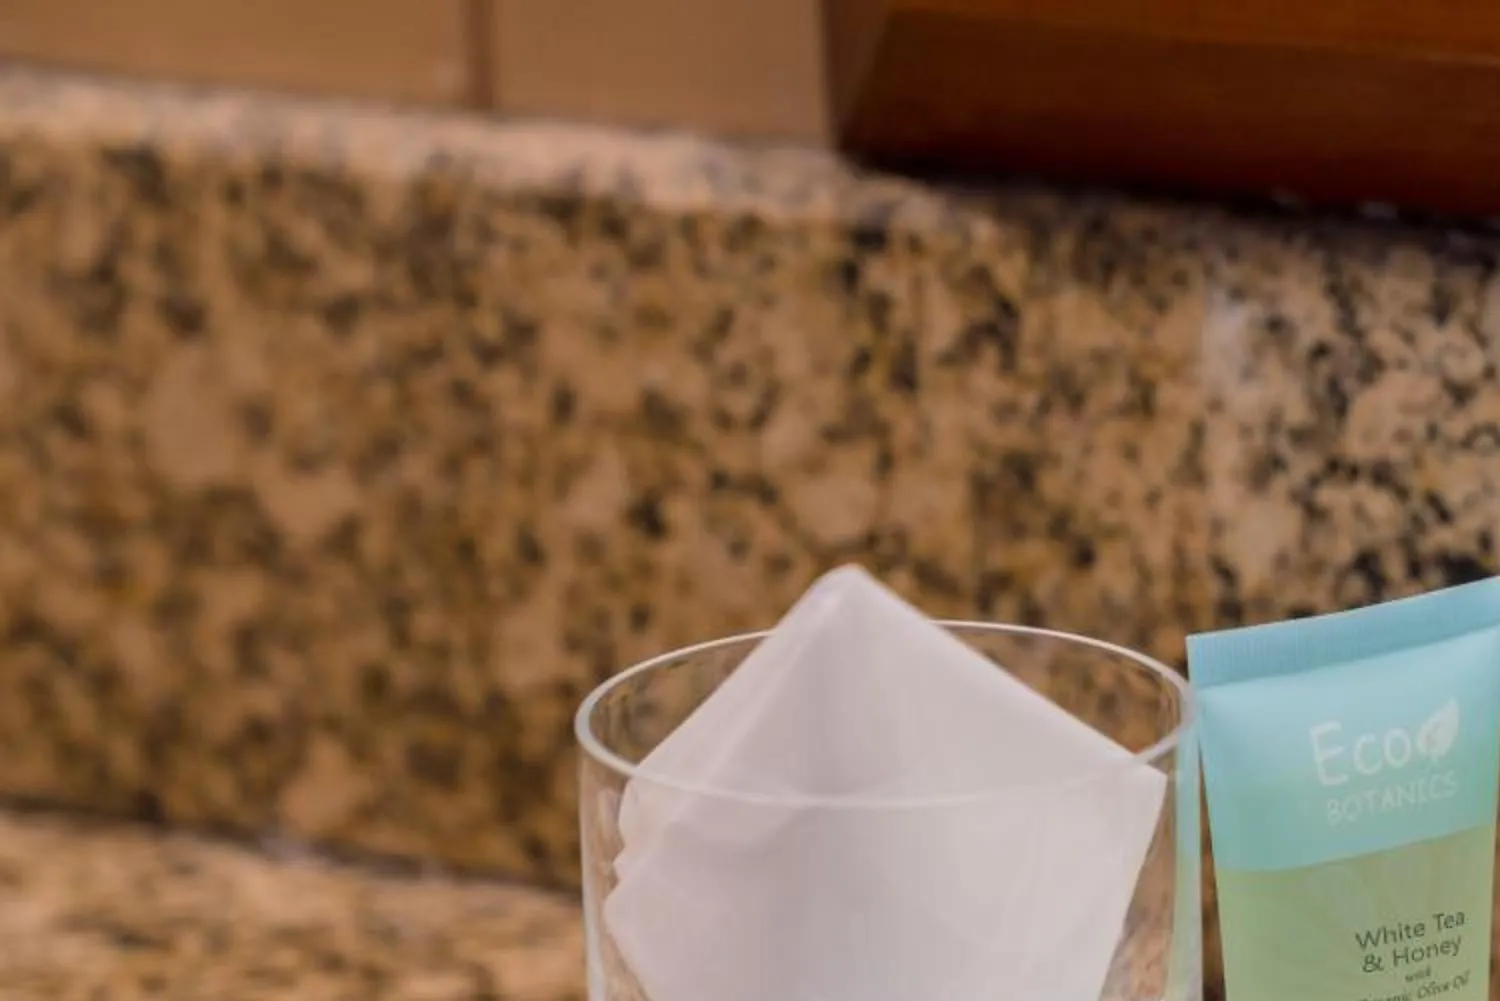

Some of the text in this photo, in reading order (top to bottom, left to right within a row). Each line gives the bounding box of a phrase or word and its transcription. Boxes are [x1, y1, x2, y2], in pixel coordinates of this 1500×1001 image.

[1326, 769, 1459, 825] BOTANICS
[1355, 911, 1465, 949] White Tea
[1362, 935, 1462, 973] & Honey
